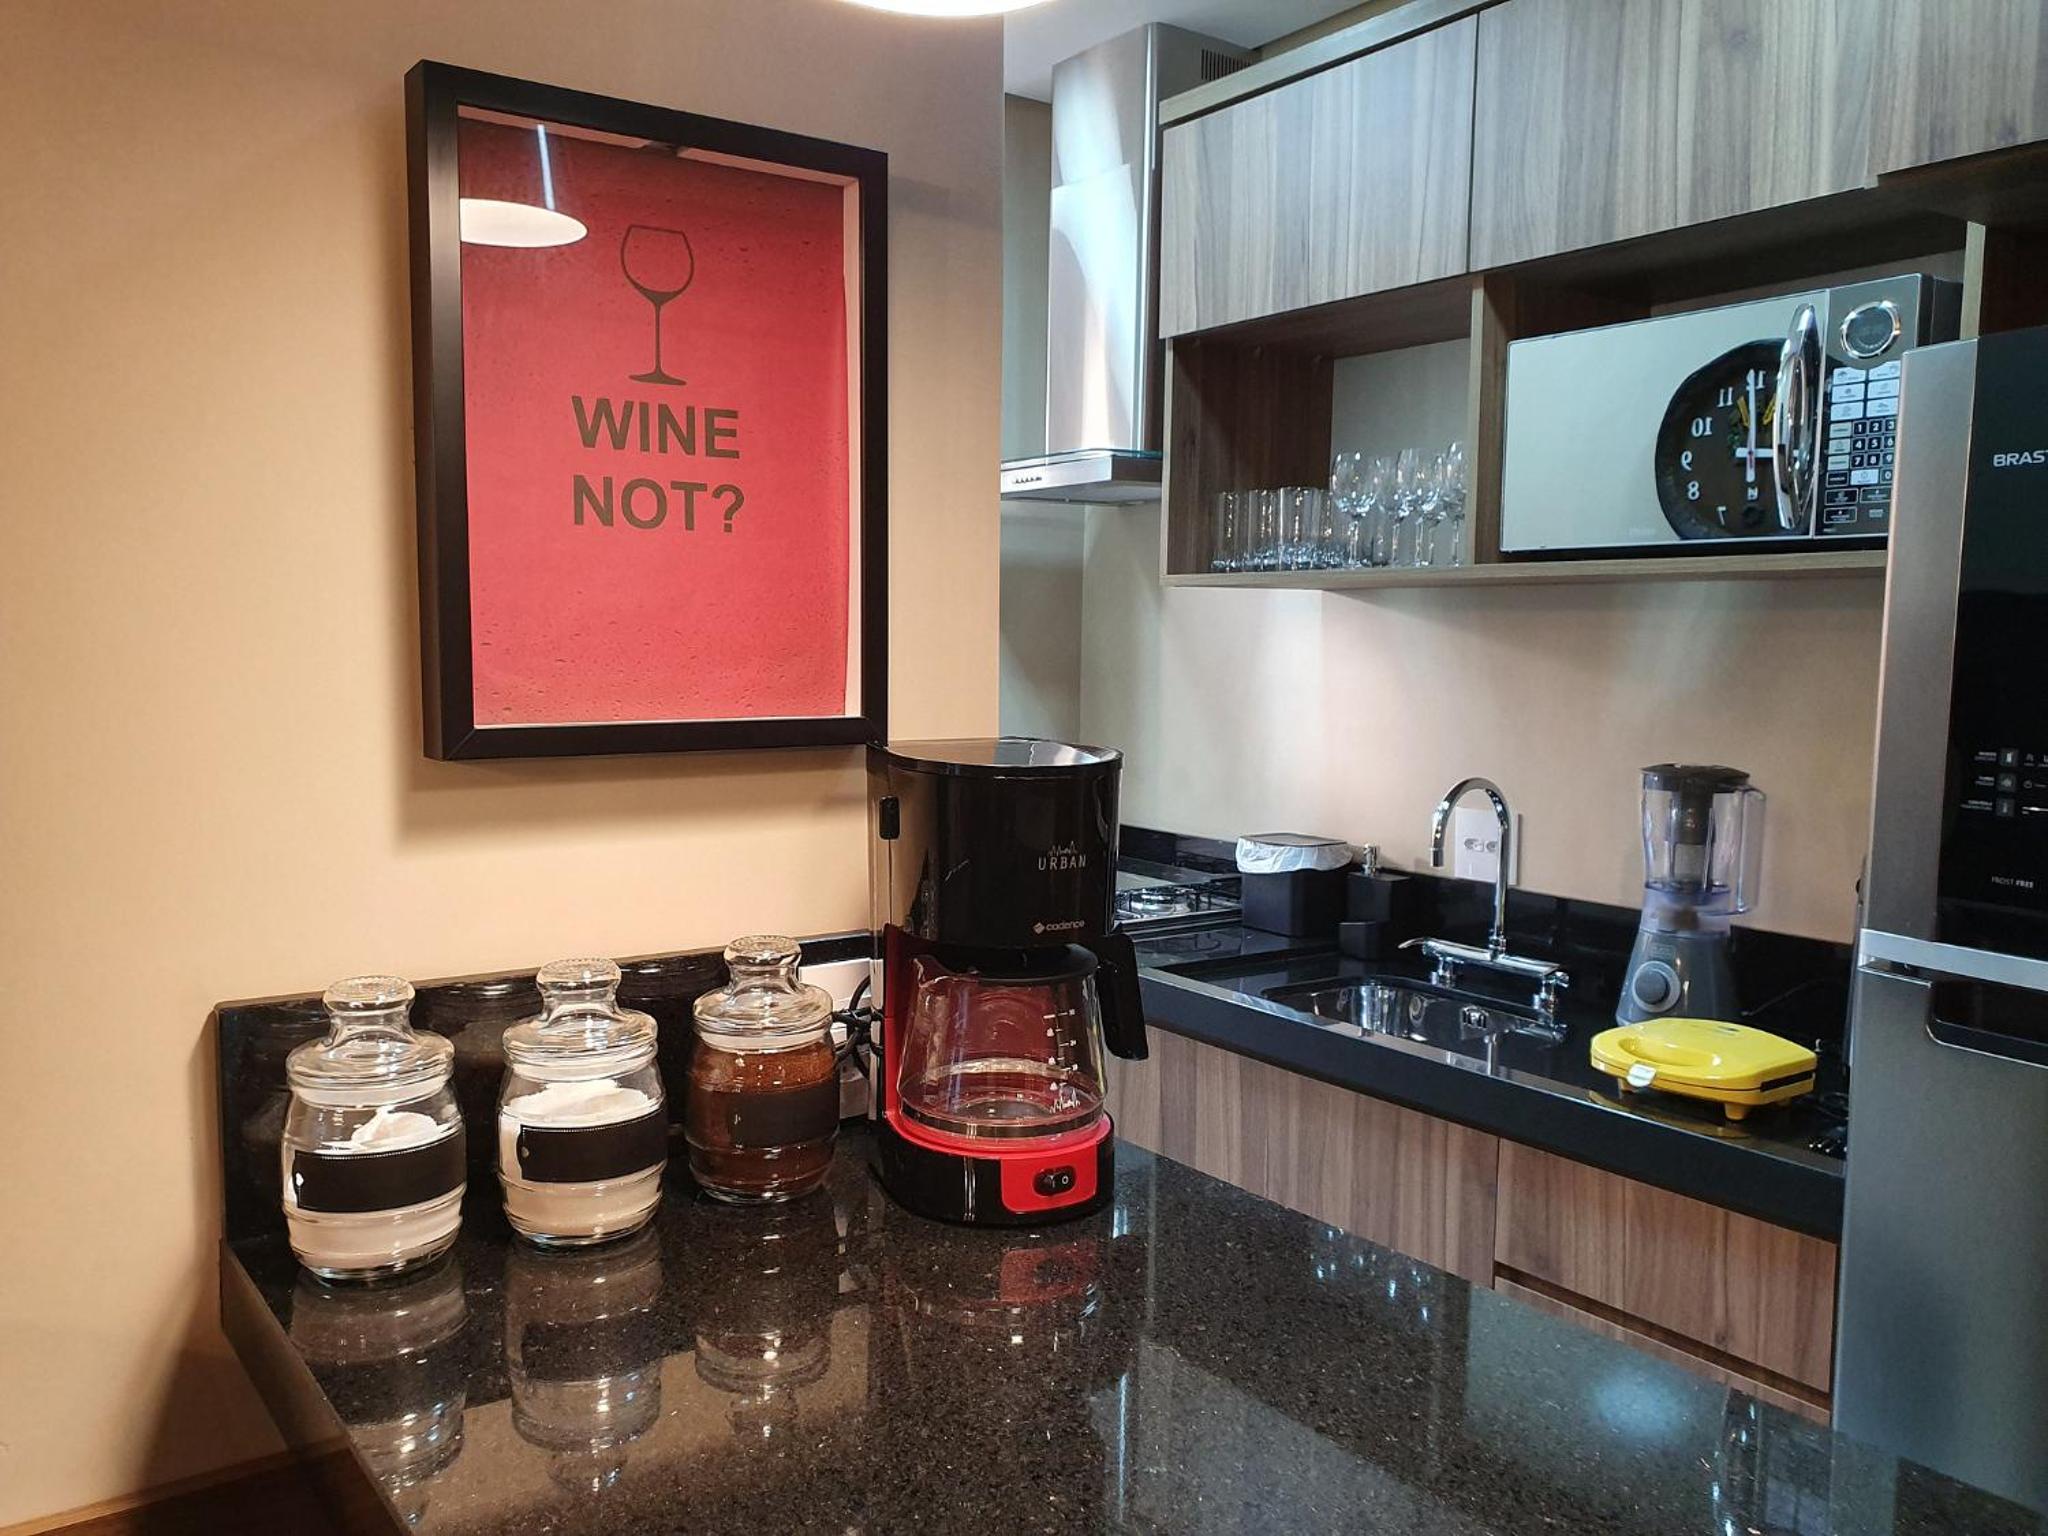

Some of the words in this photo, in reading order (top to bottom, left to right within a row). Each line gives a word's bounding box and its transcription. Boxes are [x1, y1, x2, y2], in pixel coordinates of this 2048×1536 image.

[571, 395, 740, 459] WINE
[1993, 449, 2048, 467] BRAS
[573, 474, 745, 533] NOT?
[1038, 854, 1087, 871] URBAN
[1045, 920, 1085, 931] cadence
